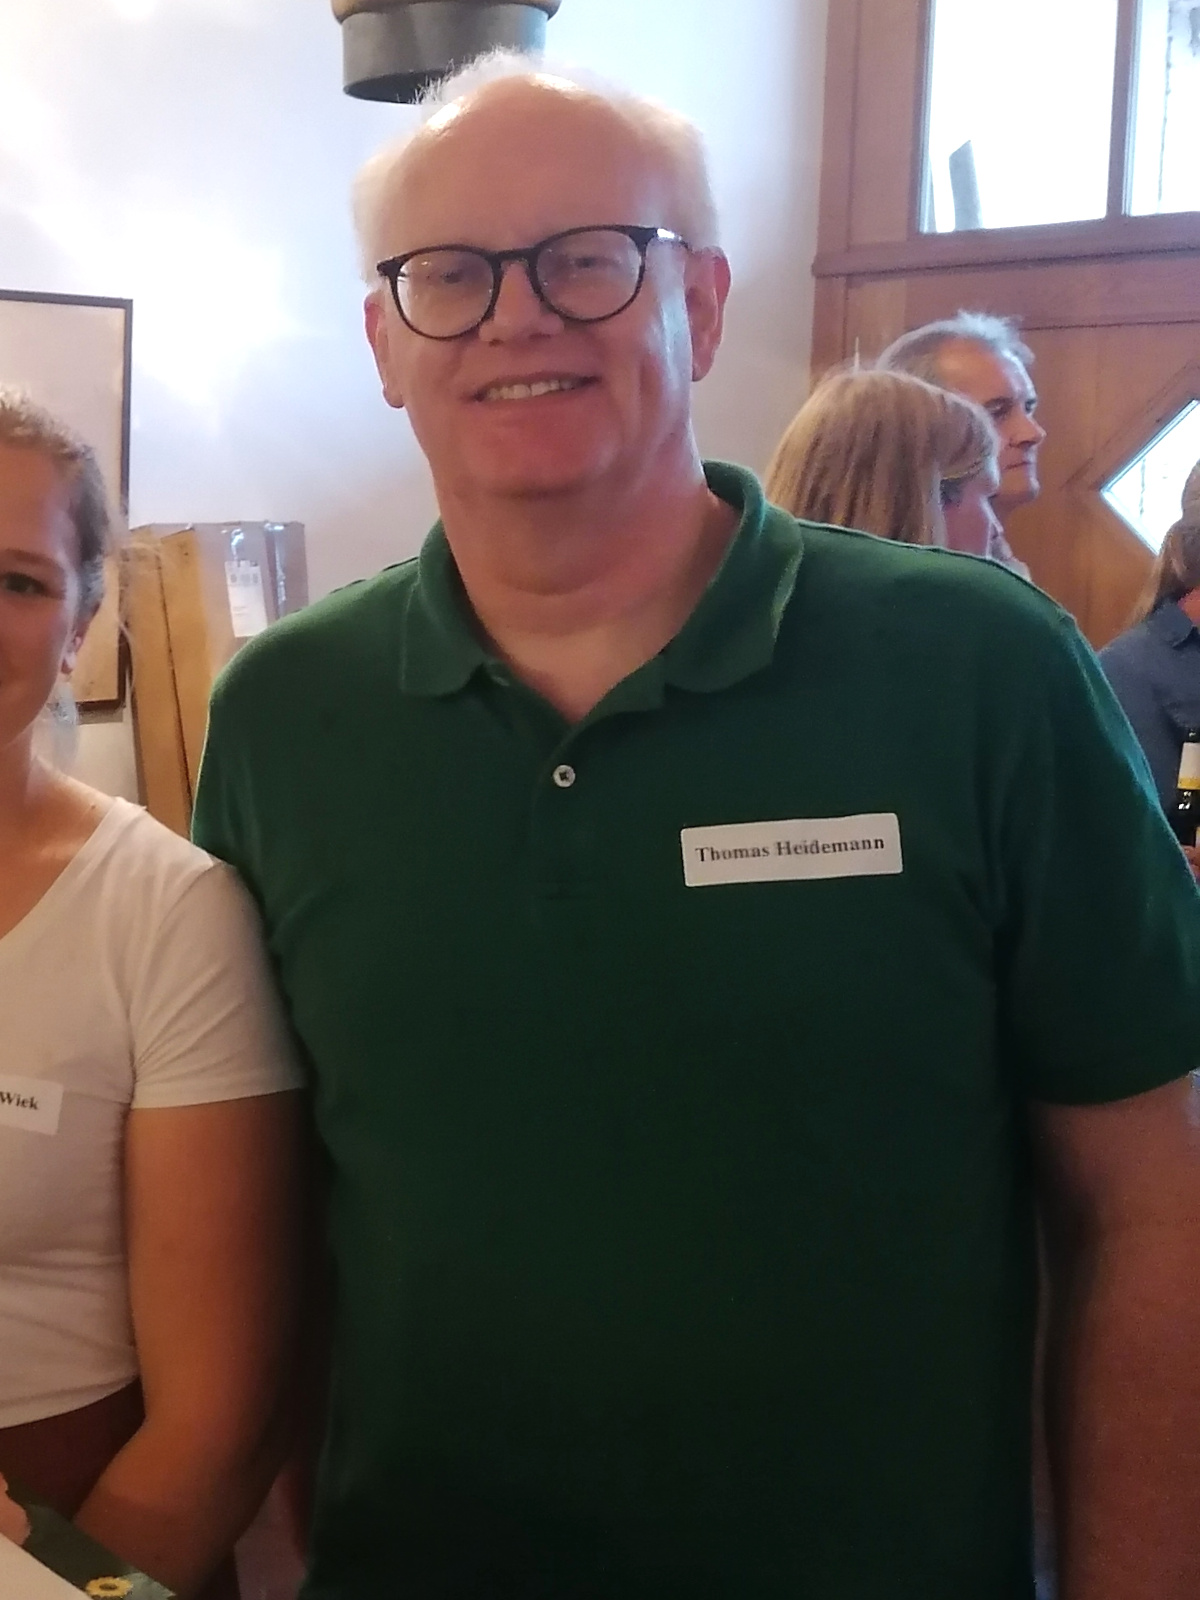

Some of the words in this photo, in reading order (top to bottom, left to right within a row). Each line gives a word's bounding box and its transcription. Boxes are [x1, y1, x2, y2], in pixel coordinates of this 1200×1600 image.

[695, 846, 770, 863] Thomas
[776, 838, 884, 855] Heidemann
[0, 1091, 39, 1110] Wiek
